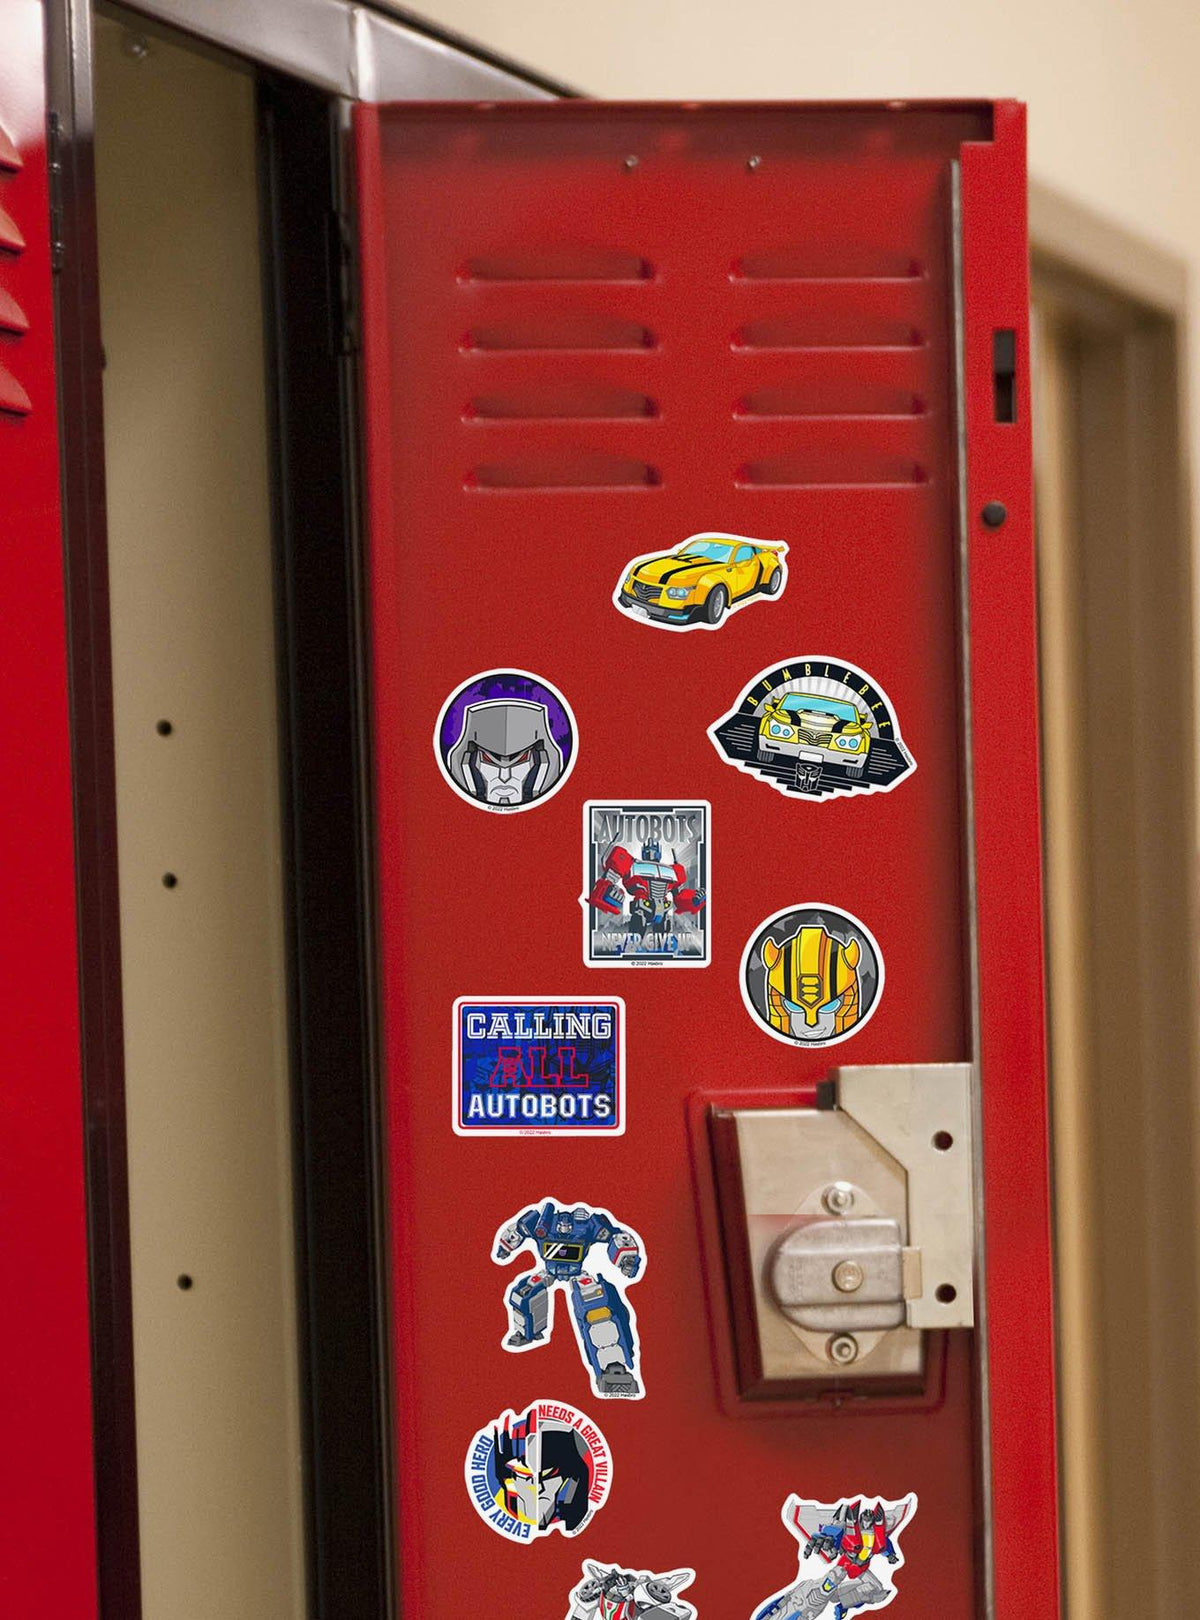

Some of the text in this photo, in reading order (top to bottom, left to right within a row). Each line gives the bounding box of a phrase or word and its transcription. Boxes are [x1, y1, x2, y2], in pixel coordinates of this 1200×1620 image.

[747, 663, 891, 728] BUMBLEBEE
[599, 815, 697, 843] AUTOBOTS
[601, 932, 643, 951] NEVER
[643, 932, 677, 951] GIVE
[467, 1013, 611, 1039] CALLING
[489, 1047, 588, 1088] ALL
[468, 1093, 611, 1119] AUTOBOTS
[538, 1404, 608, 1503] NEEDS A GREAT VILLAIN
[471, 1435, 531, 1539] EVERY GOOD HERO
